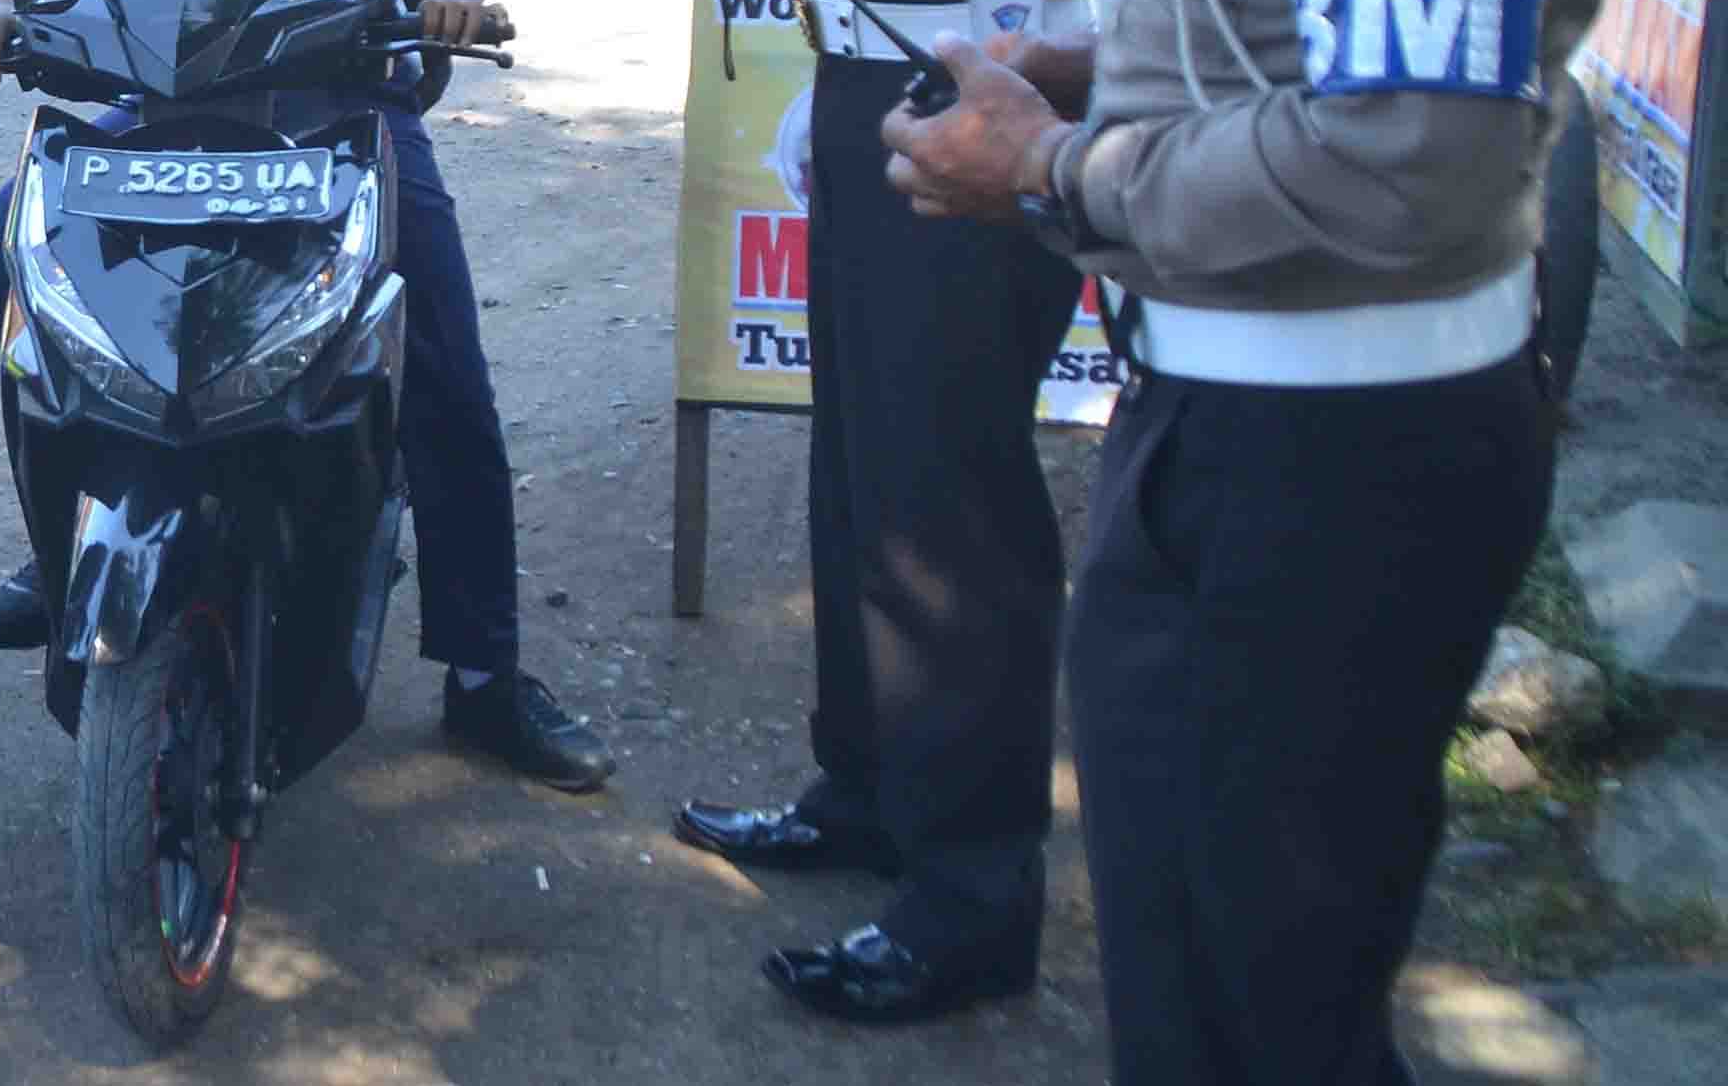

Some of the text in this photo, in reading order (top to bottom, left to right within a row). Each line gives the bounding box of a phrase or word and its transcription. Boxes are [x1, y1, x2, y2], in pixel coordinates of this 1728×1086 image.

[82, 155, 316, 193] P 5265 UA
[735, 322, 810, 366] Tu
